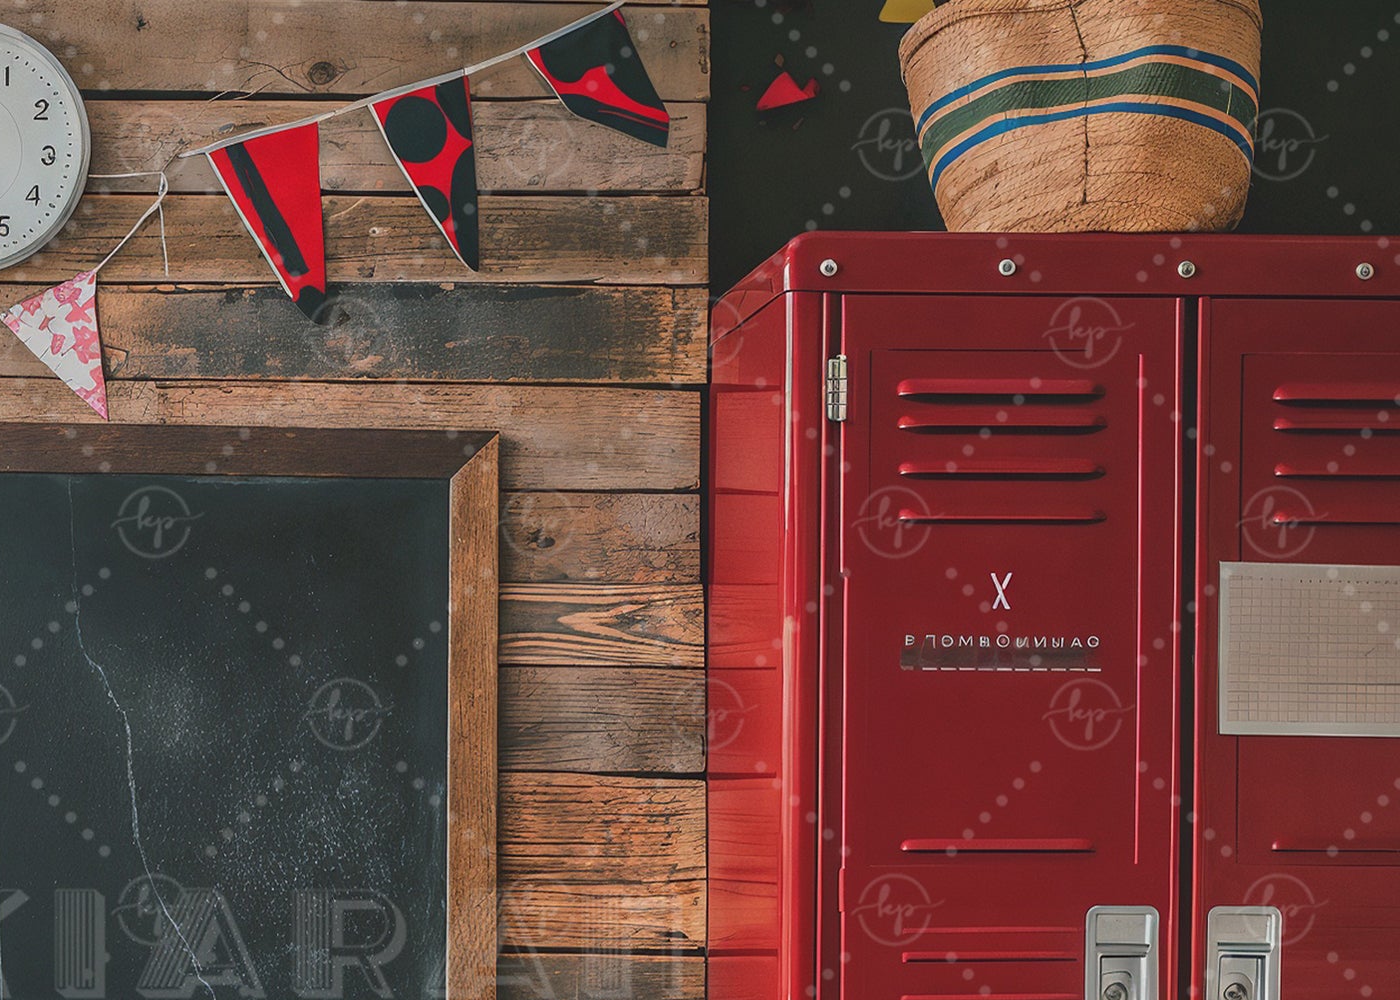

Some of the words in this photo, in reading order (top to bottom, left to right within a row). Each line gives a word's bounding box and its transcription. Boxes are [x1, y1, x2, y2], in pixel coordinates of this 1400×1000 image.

[4, 65, 10, 87] 1
[33, 98, 50, 121] 2
[40, 144, 57, 166] 3
[25, 184, 41, 207] 4
